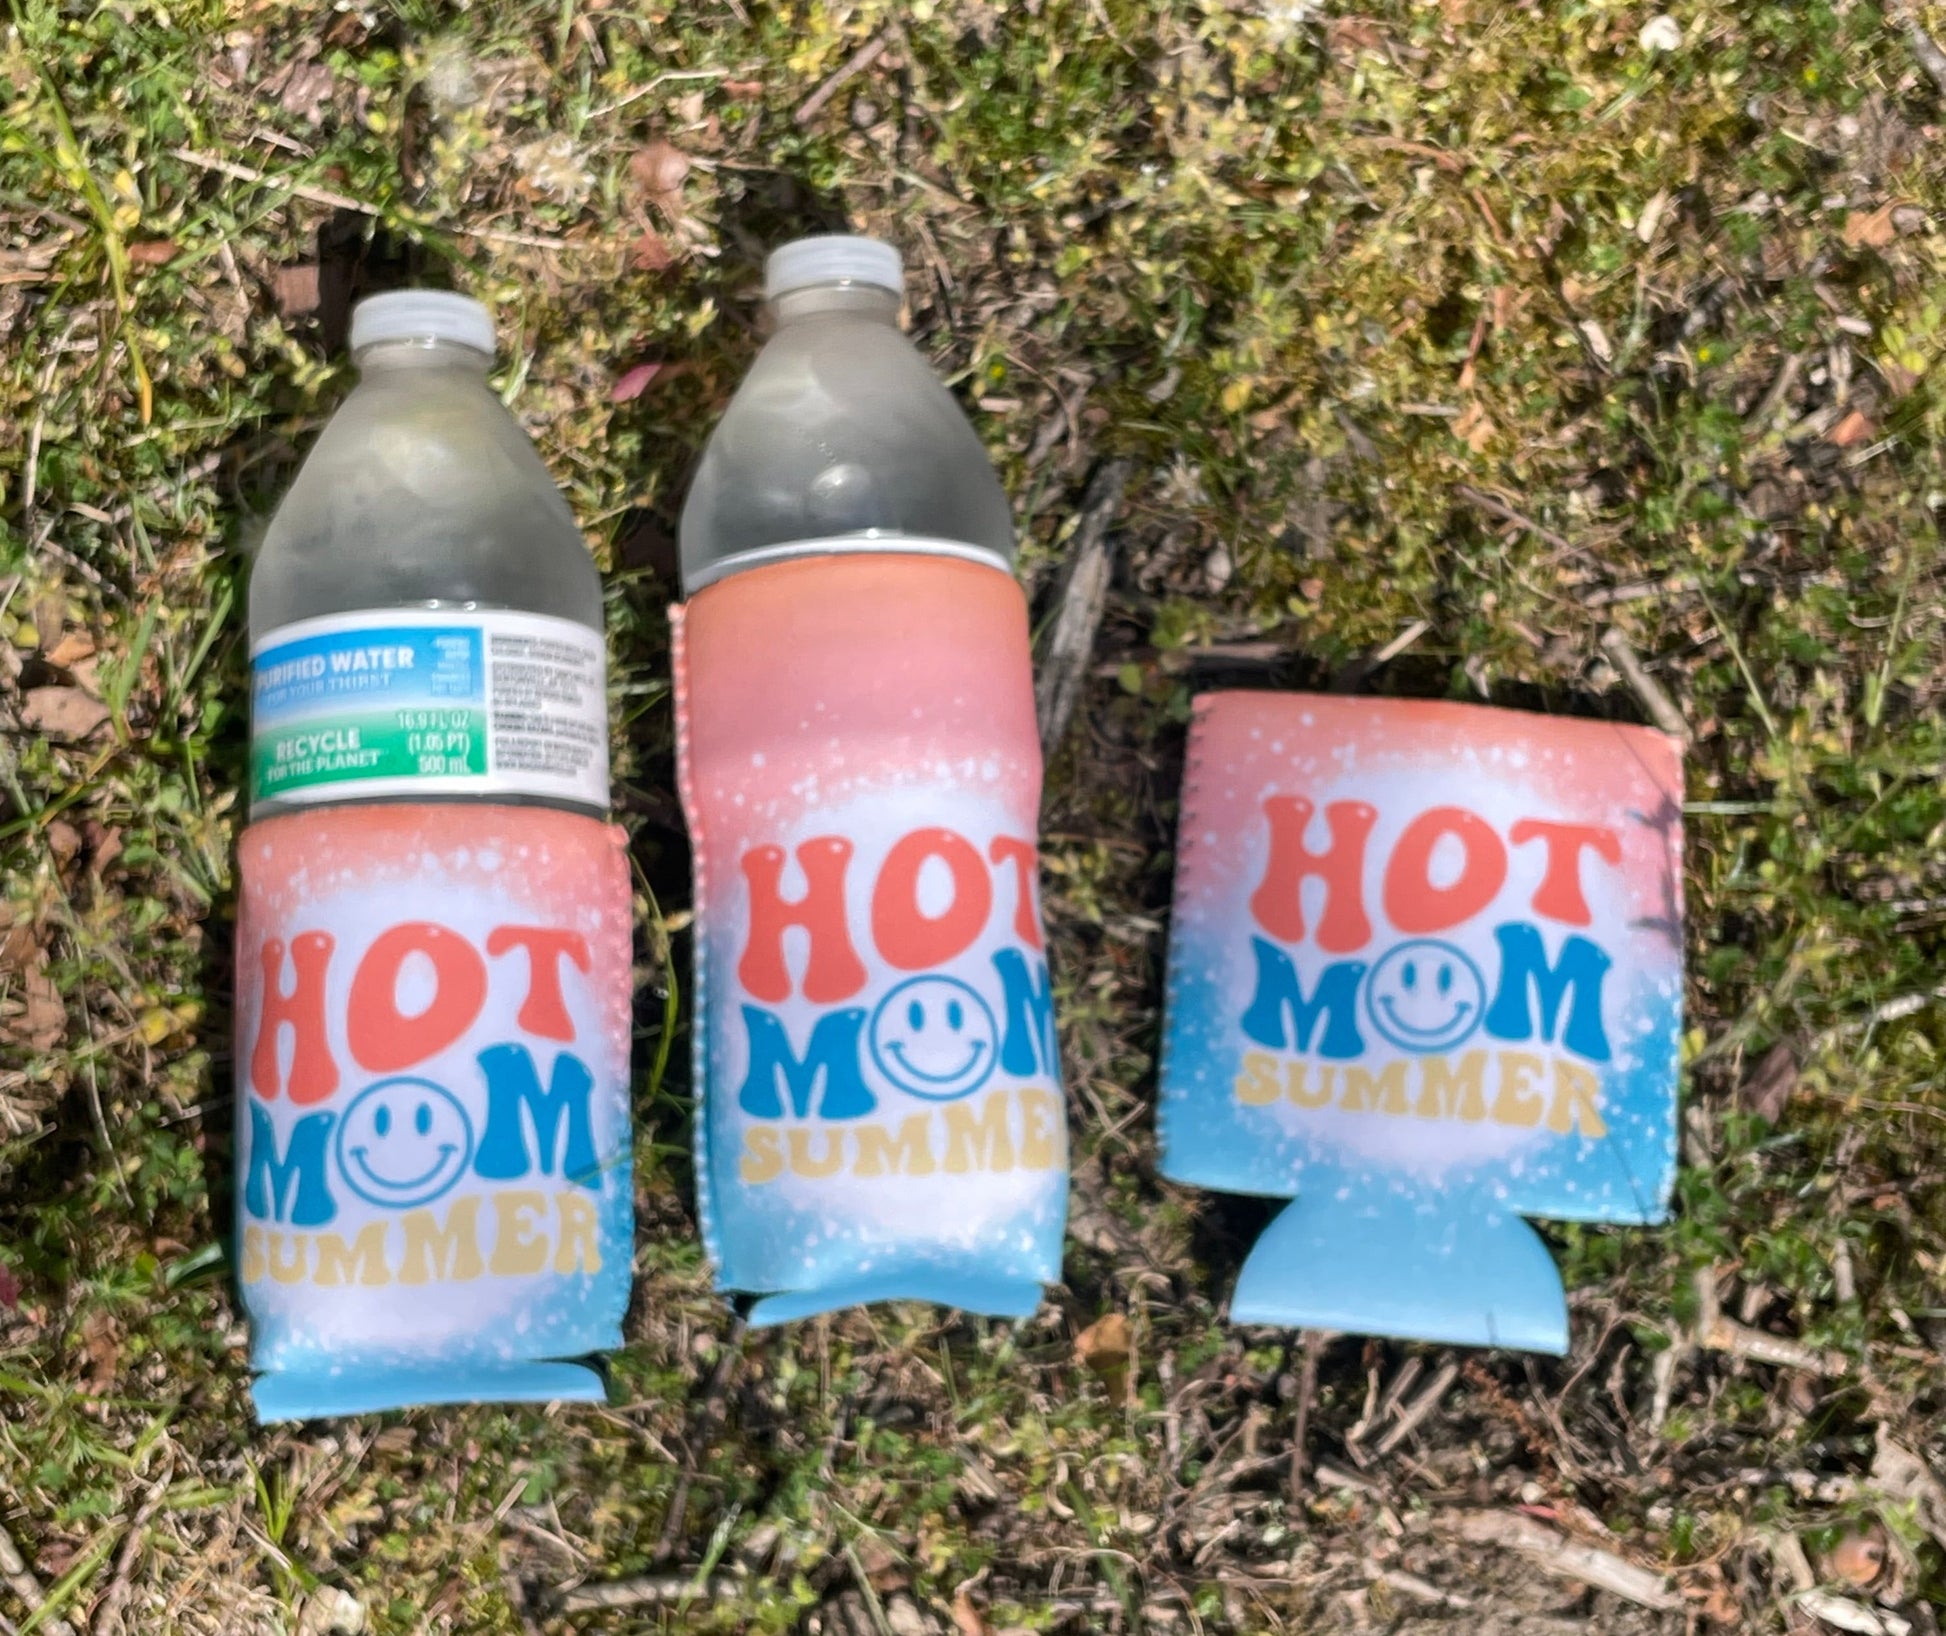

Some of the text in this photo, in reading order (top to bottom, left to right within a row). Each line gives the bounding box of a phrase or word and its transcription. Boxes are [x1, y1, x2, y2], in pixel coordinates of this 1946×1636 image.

[289, 680, 325, 698] YOUR
[330, 645, 415, 672] WATER
[276, 728, 362, 763] RECYCLE
[316, 749, 381, 774] PLANET
[430, 711, 448, 729] FL
[451, 711, 469, 729] OZ
[738, 826, 1044, 1005] HOT
[1250, 796, 1621, 953] HOT
[251, 921, 591, 1106] HOT
[739, 1088, 1068, 1185] SUMME
[1235, 1051, 1607, 1138] SUMMER
[242, 1190, 602, 1287] SUMMER
